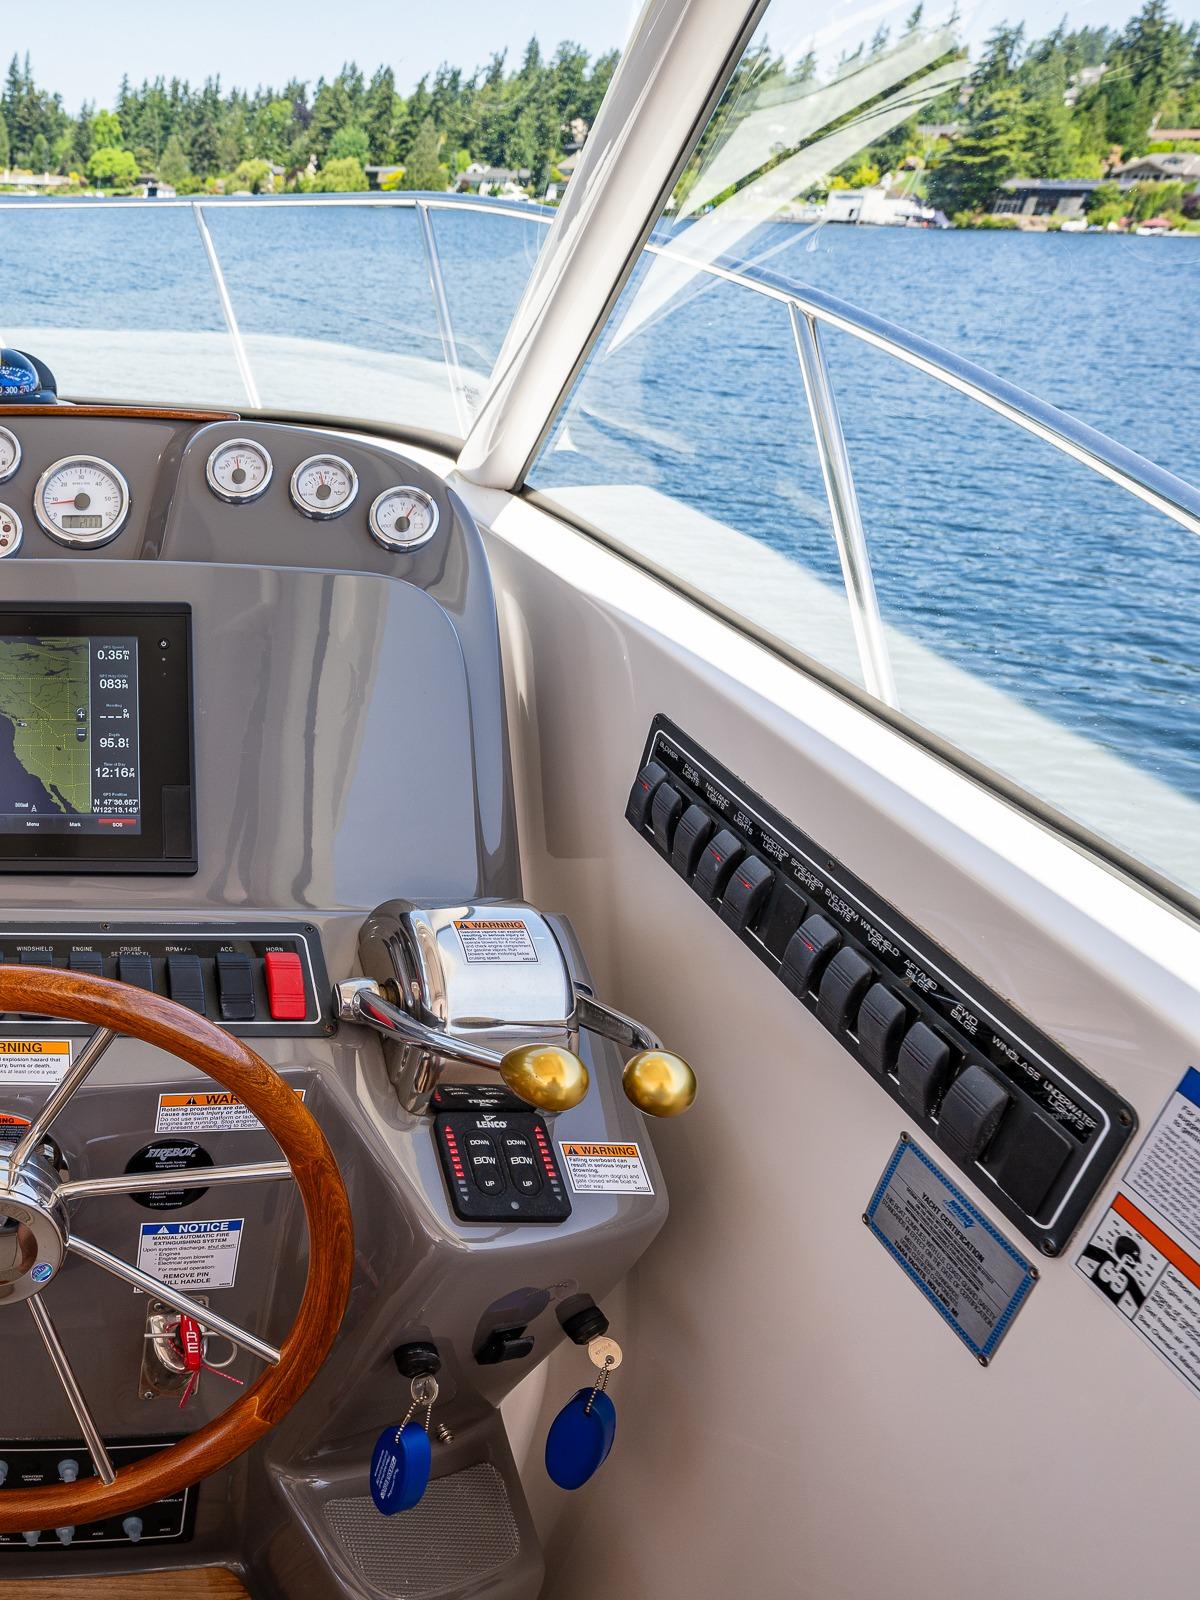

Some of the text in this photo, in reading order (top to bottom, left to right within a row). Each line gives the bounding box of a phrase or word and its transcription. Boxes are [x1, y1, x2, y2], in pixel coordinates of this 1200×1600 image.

[5, 386, 17, 394] 300
[97, 650, 123, 660] 0.35
[100, 679, 121, 688] 083
[100, 738, 125, 748] 95.8
[659, 741, 678, 761] BLOWER
[96, 767, 129, 778] 12:16
[682, 768, 699, 787] LIGHTS
[684, 763, 699, 778] PANEL
[705, 782, 730, 807] NAV/ANC
[707, 790, 725, 810] LIGHTS
[733, 815, 753, 835] LIGHTS
[737, 811, 752, 825] CTSY
[760, 832, 789, 858] HARDTOP
[762, 842, 783, 861] LIGHTS
[790, 857, 824, 890] SPREADER
[794, 869, 815, 891] LIGHTS
[828, 899, 851, 923] LIGHTS
[839, 900, 858, 922] ROOM
[860, 918, 900, 957] WINDSHIELD
[867, 934, 886, 954] VENT
[903, 959, 937, 990] AFT/MID
[905, 968, 930, 993] BILGE
[951, 1009, 978, 1036] BILGE
[955, 1004, 978, 1026] FWD
[992, 1035, 1041, 1081] WINDLASS
[581, 1146, 635, 1155] WARNING
[179, 1222, 229, 1233] NOTICE
[921, 1191, 940, 1215] YACHT
[940, 1212, 984, 1263] CERTIFICATION
